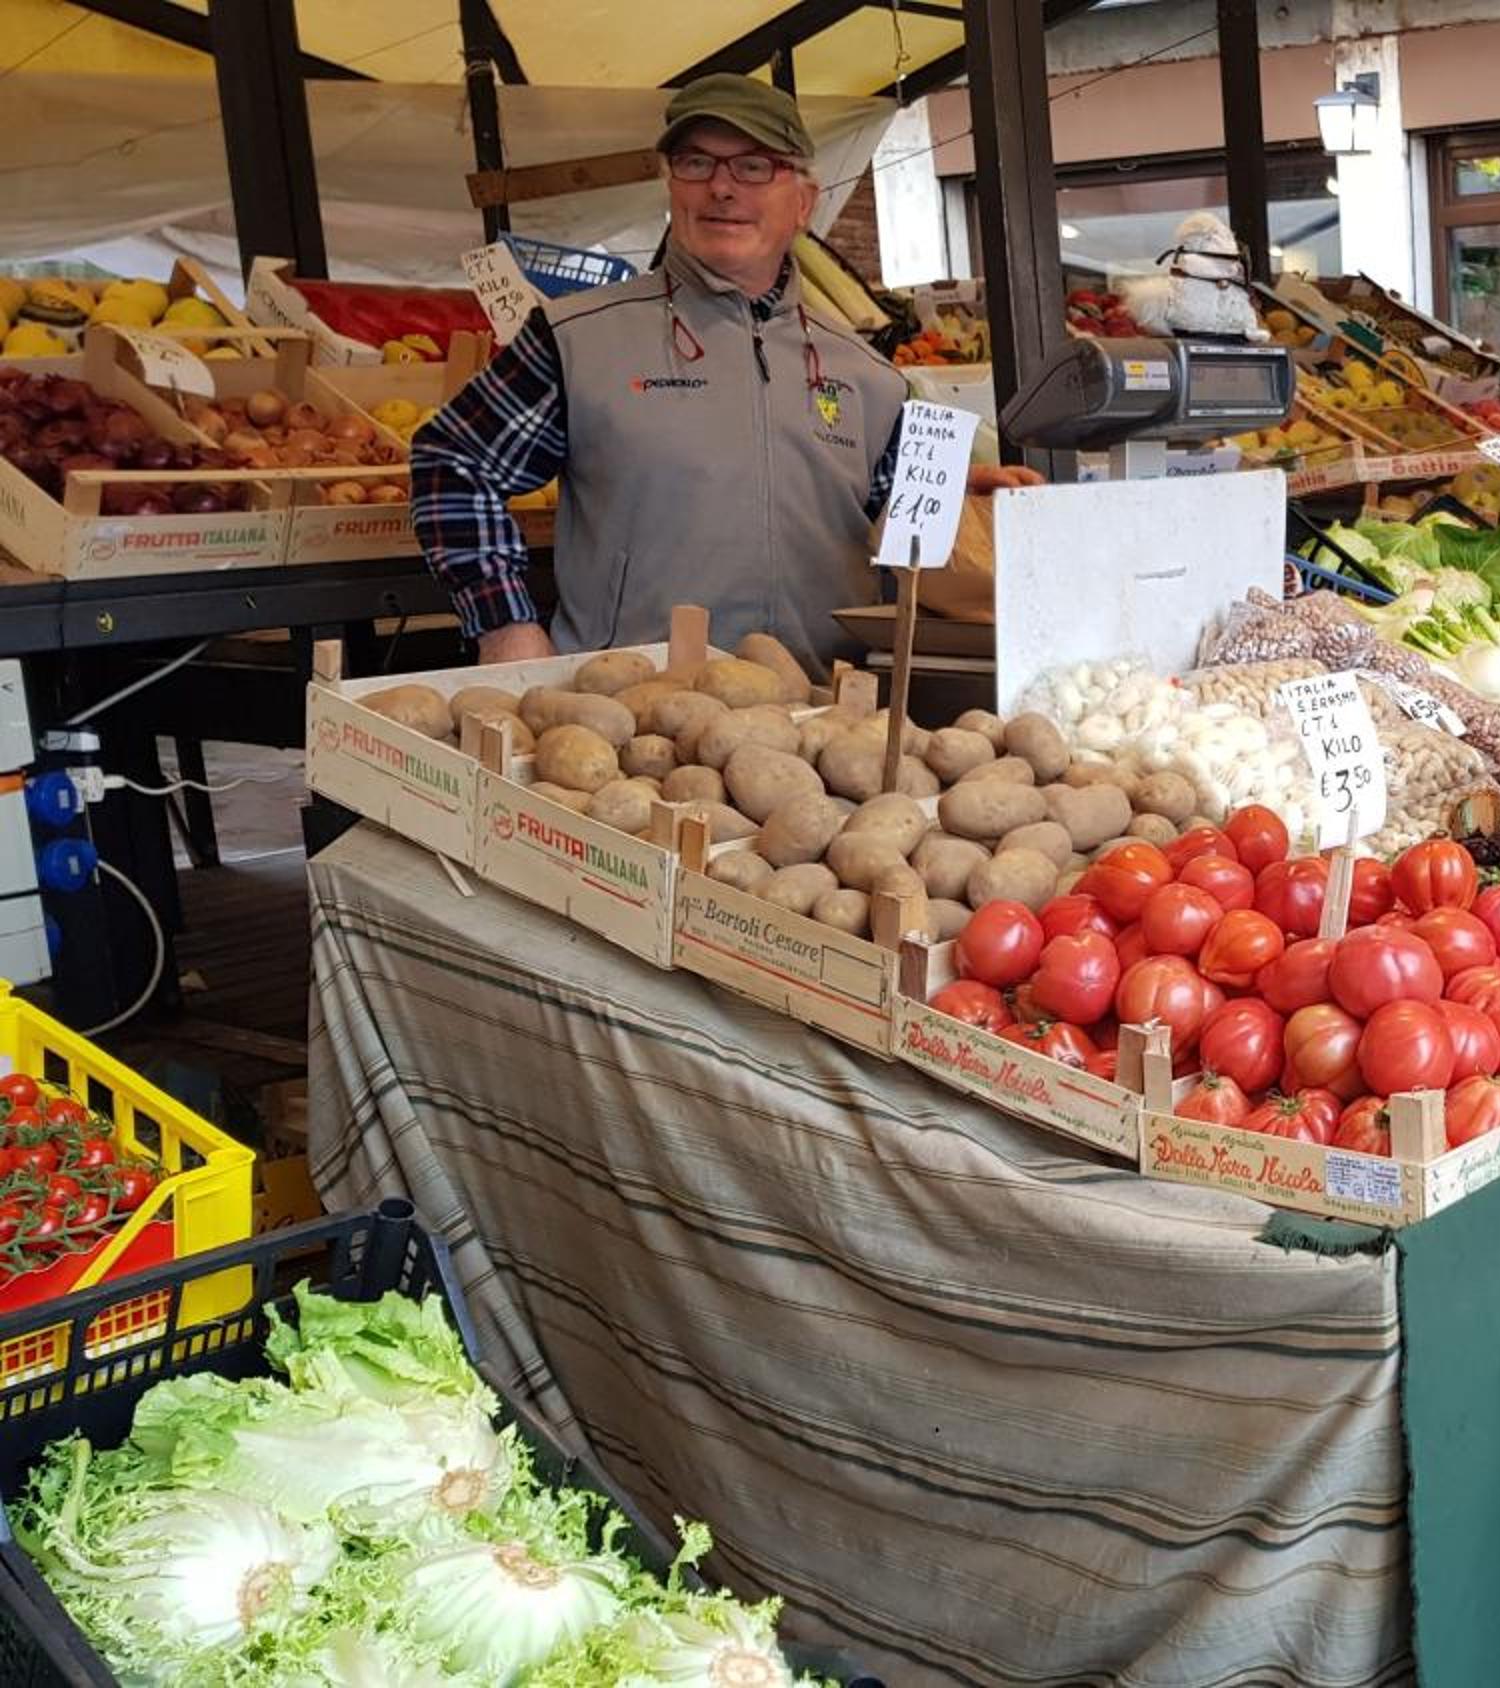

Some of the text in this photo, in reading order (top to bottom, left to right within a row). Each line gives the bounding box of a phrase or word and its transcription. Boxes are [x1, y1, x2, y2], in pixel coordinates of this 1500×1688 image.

[911, 405, 954, 421] ITALIA
[906, 464, 946, 485] KILO
[1288, 680, 1336, 698] ITALIA
[1321, 734, 1362, 761] KILO
[704, 898, 760, 937] Bartoli
[763, 922, 819, 963] Cesare
[1155, 1133, 1207, 1168] Dalla
[1256, 1155, 1323, 1193] Nicola
